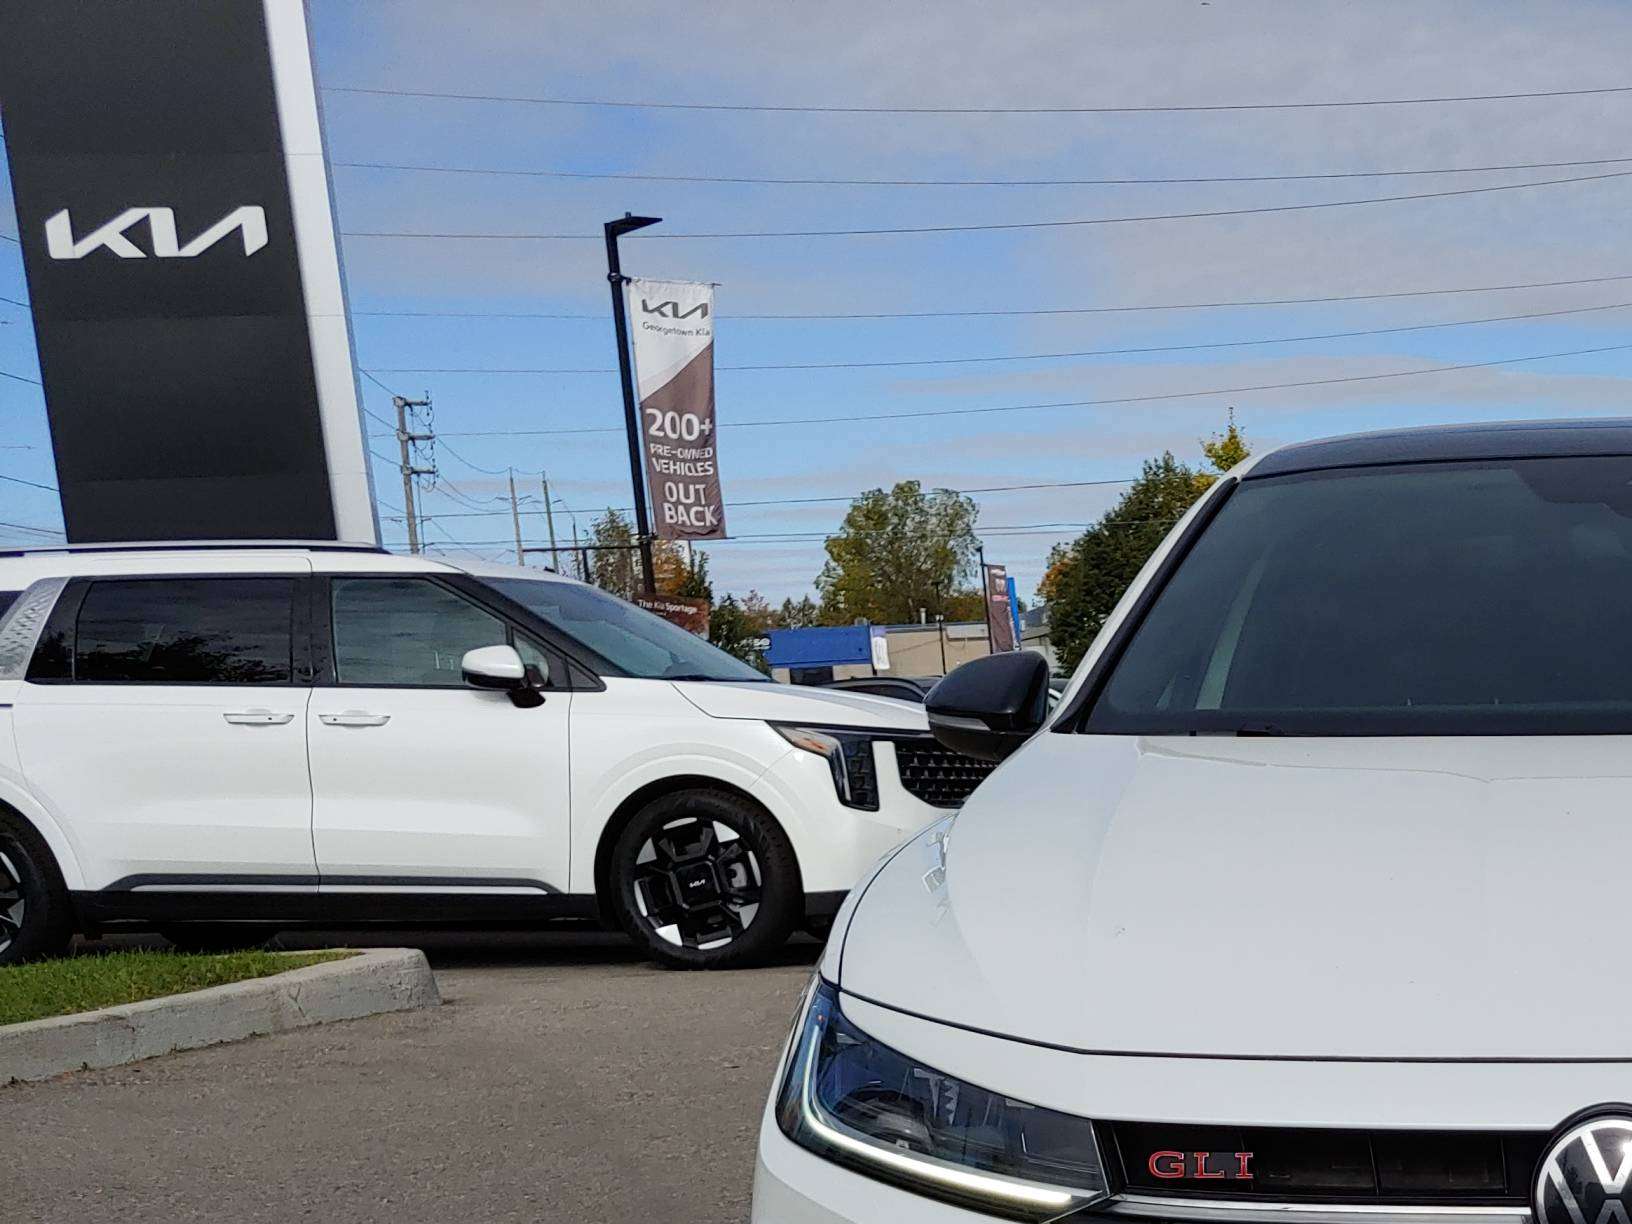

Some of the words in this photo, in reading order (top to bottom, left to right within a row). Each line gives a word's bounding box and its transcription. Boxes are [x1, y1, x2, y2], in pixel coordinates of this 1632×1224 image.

[45, 206, 268, 259] KIA
[642, 299, 709, 319] KIA
[642, 322, 694, 336] Georgetown
[695, 328, 711, 336] Kia
[645, 408, 713, 441] 200+
[649, 443, 714, 460] PRE-OWNED
[651, 457, 714, 477] VEHICLES
[664, 481, 706, 505] OUT
[663, 502, 719, 527] BACK
[1148, 1150, 1254, 1179] GLI
